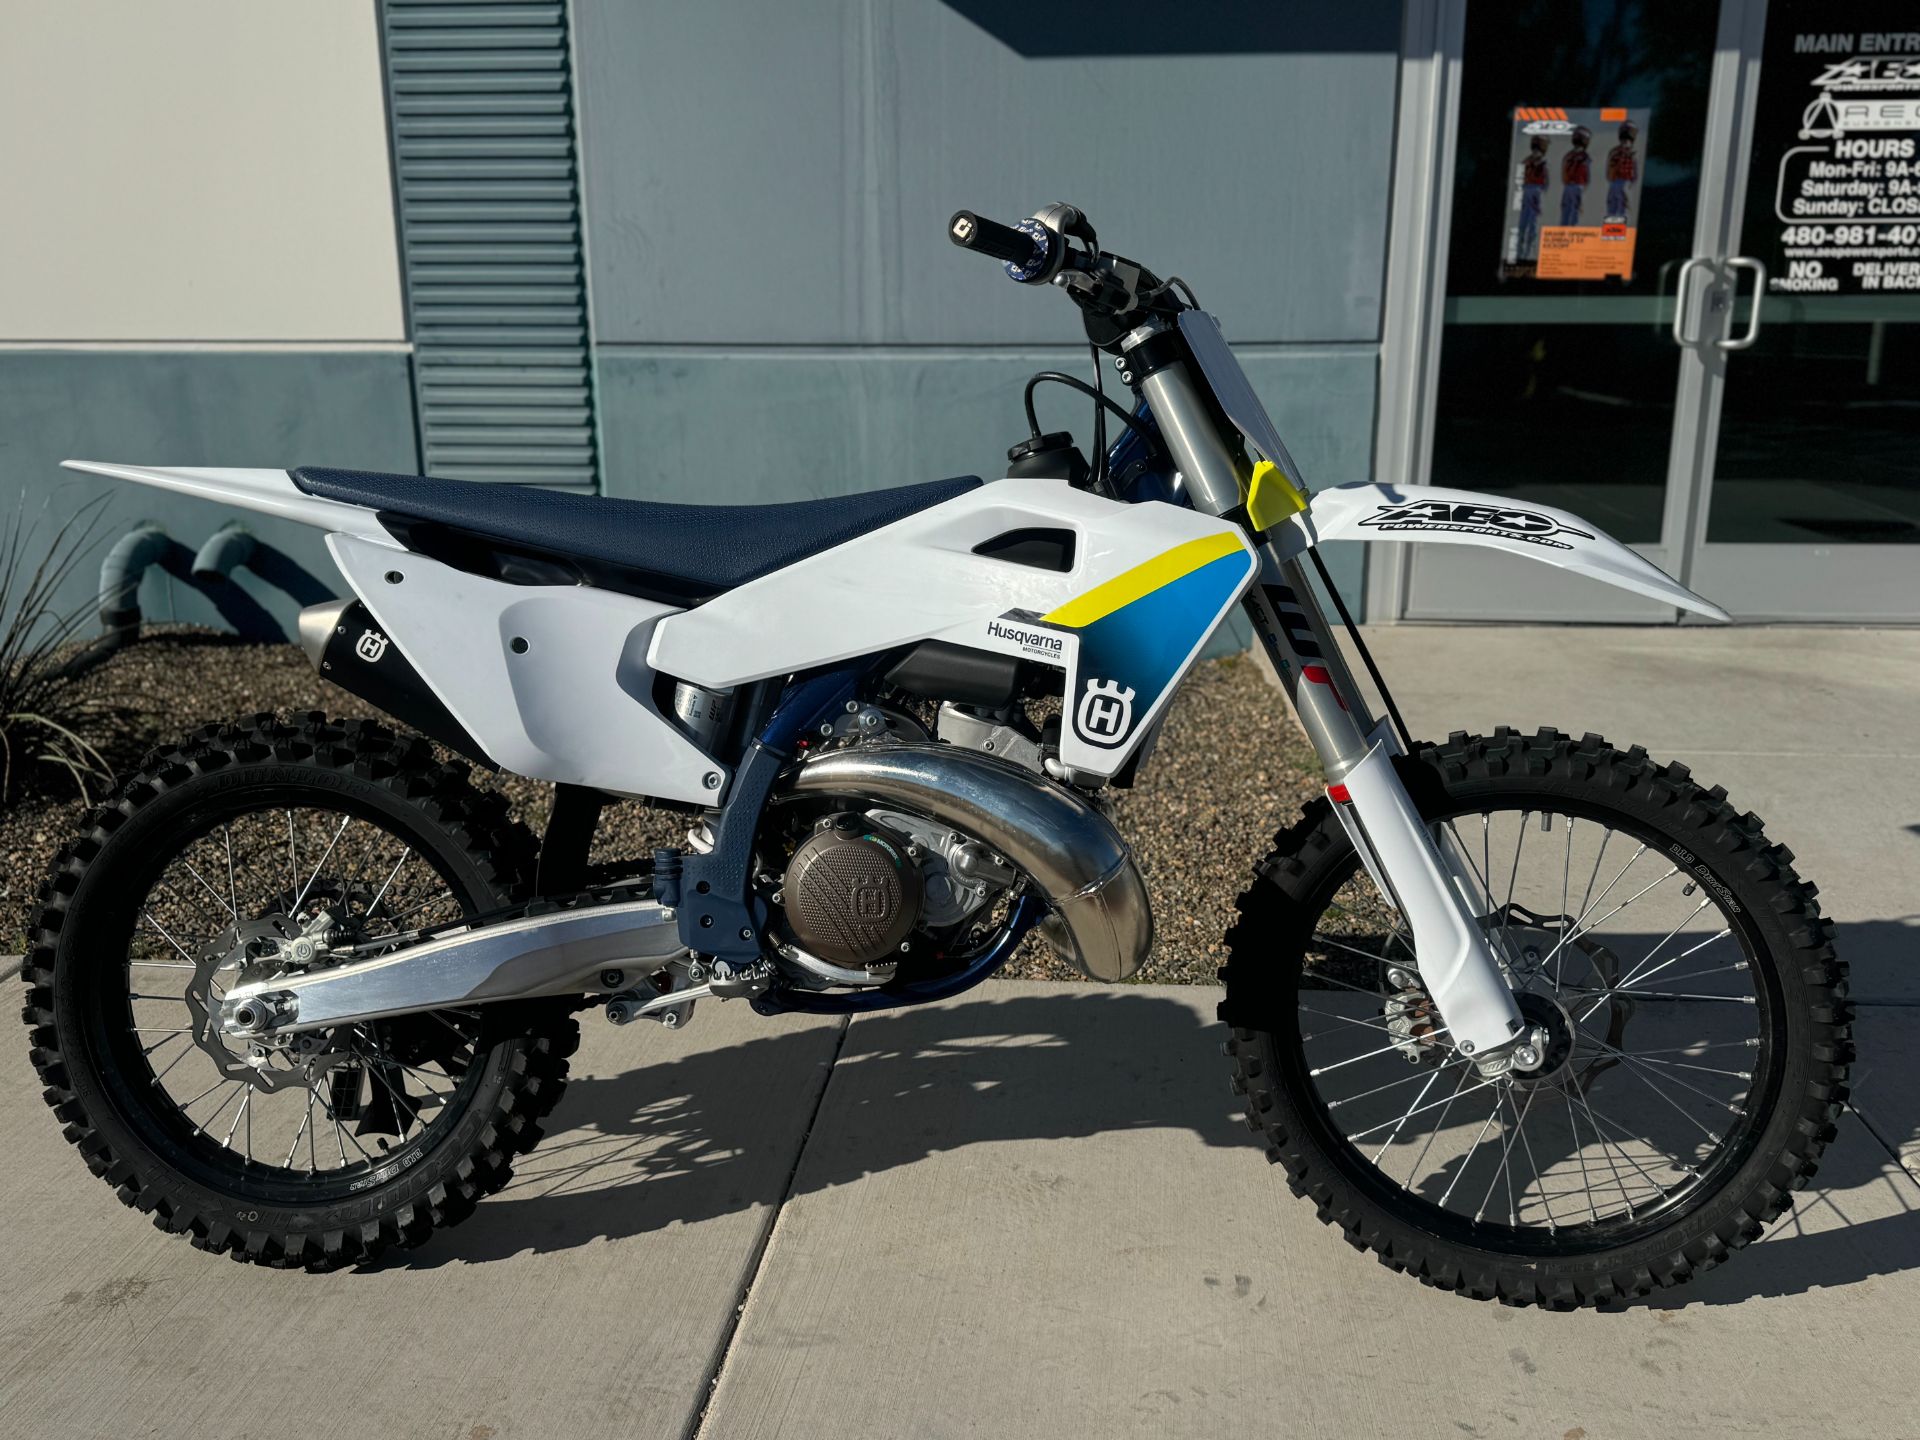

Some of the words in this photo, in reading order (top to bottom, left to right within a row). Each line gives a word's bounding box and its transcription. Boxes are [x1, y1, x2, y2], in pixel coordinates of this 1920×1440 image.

[1794, 34, 1854, 53] MAIN
[1834, 139, 1915, 159] HOURS
[1809, 161, 1882, 178] Mon-Fri:
[1801, 179, 1885, 199] Saturday:
[1888, 179, 1920, 196] 9A-
[1793, 198, 1864, 218] Sunday:
[1789, 260, 1823, 279] NO
[1862, 276, 1881, 289] IN
[1377, 502, 1554, 533] AEO
[1380, 522, 1572, 550] POWERSPORTS.COM
[987, 620, 1063, 652] Husqvarna
[1022, 646, 1061, 660] MOTORCYCLES
